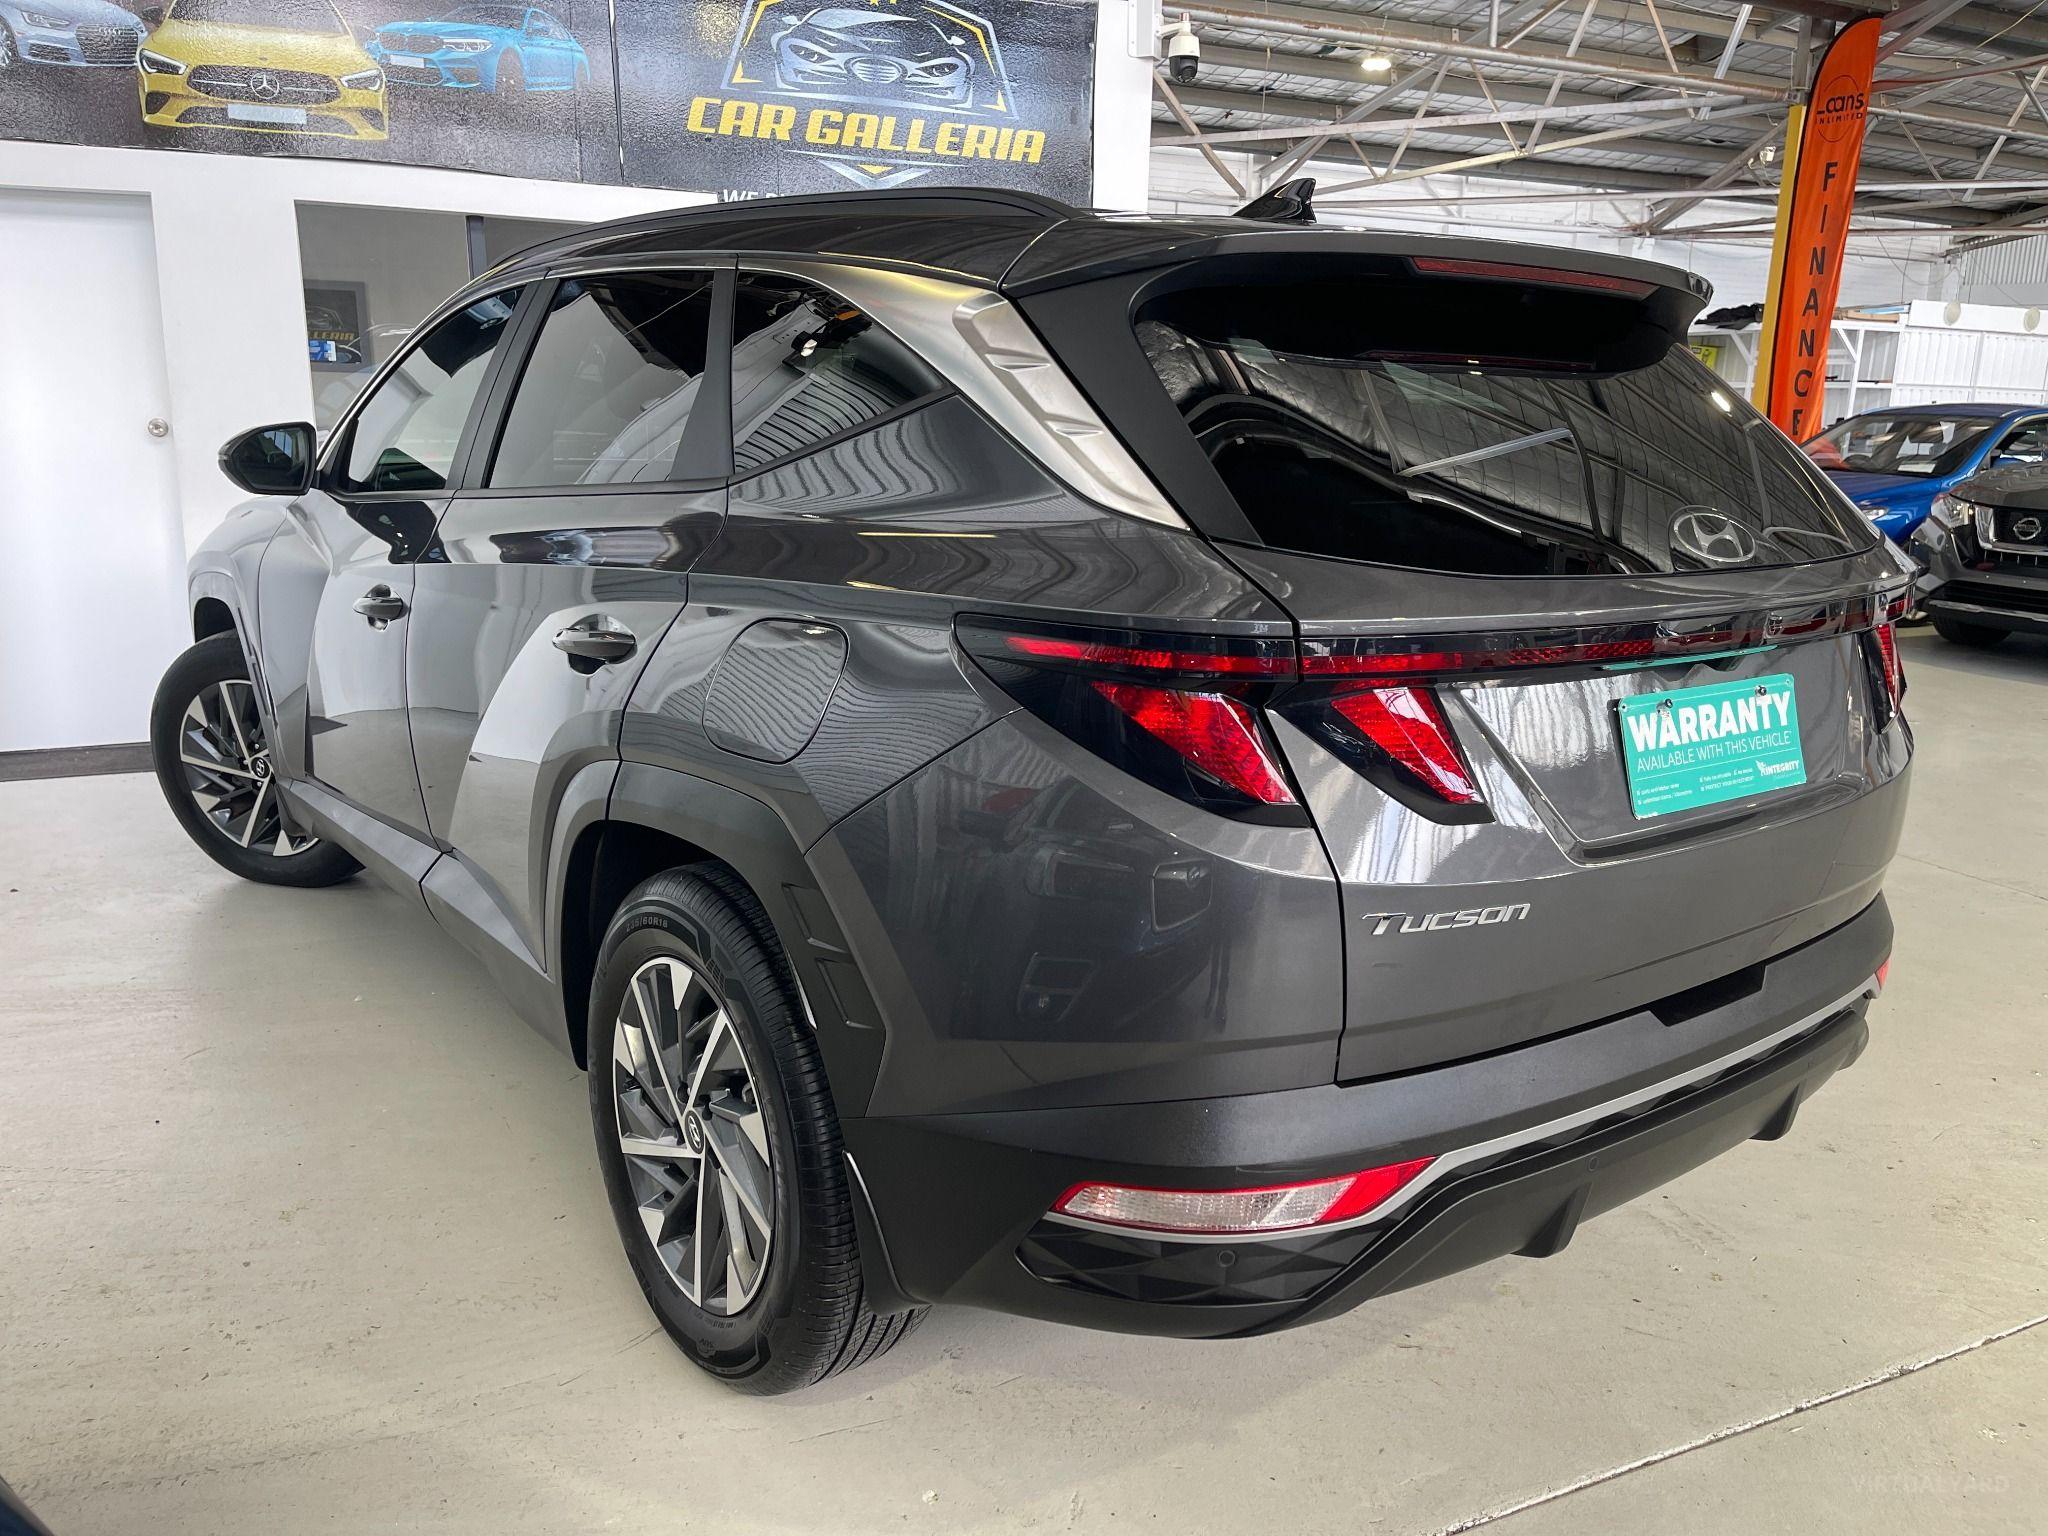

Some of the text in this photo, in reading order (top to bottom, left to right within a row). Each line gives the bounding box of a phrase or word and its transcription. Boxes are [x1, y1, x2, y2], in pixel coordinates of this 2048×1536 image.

[687, 96, 1046, 163] CAR GALLERIA
[1792, 161, 1838, 436] FINANCE
[1627, 691, 1791, 753] WARRANTY
[1637, 731, 1791, 773] AVAILABLE WITH THIS VEHICLE
[1764, 760, 1800, 776] INTEGRITY
